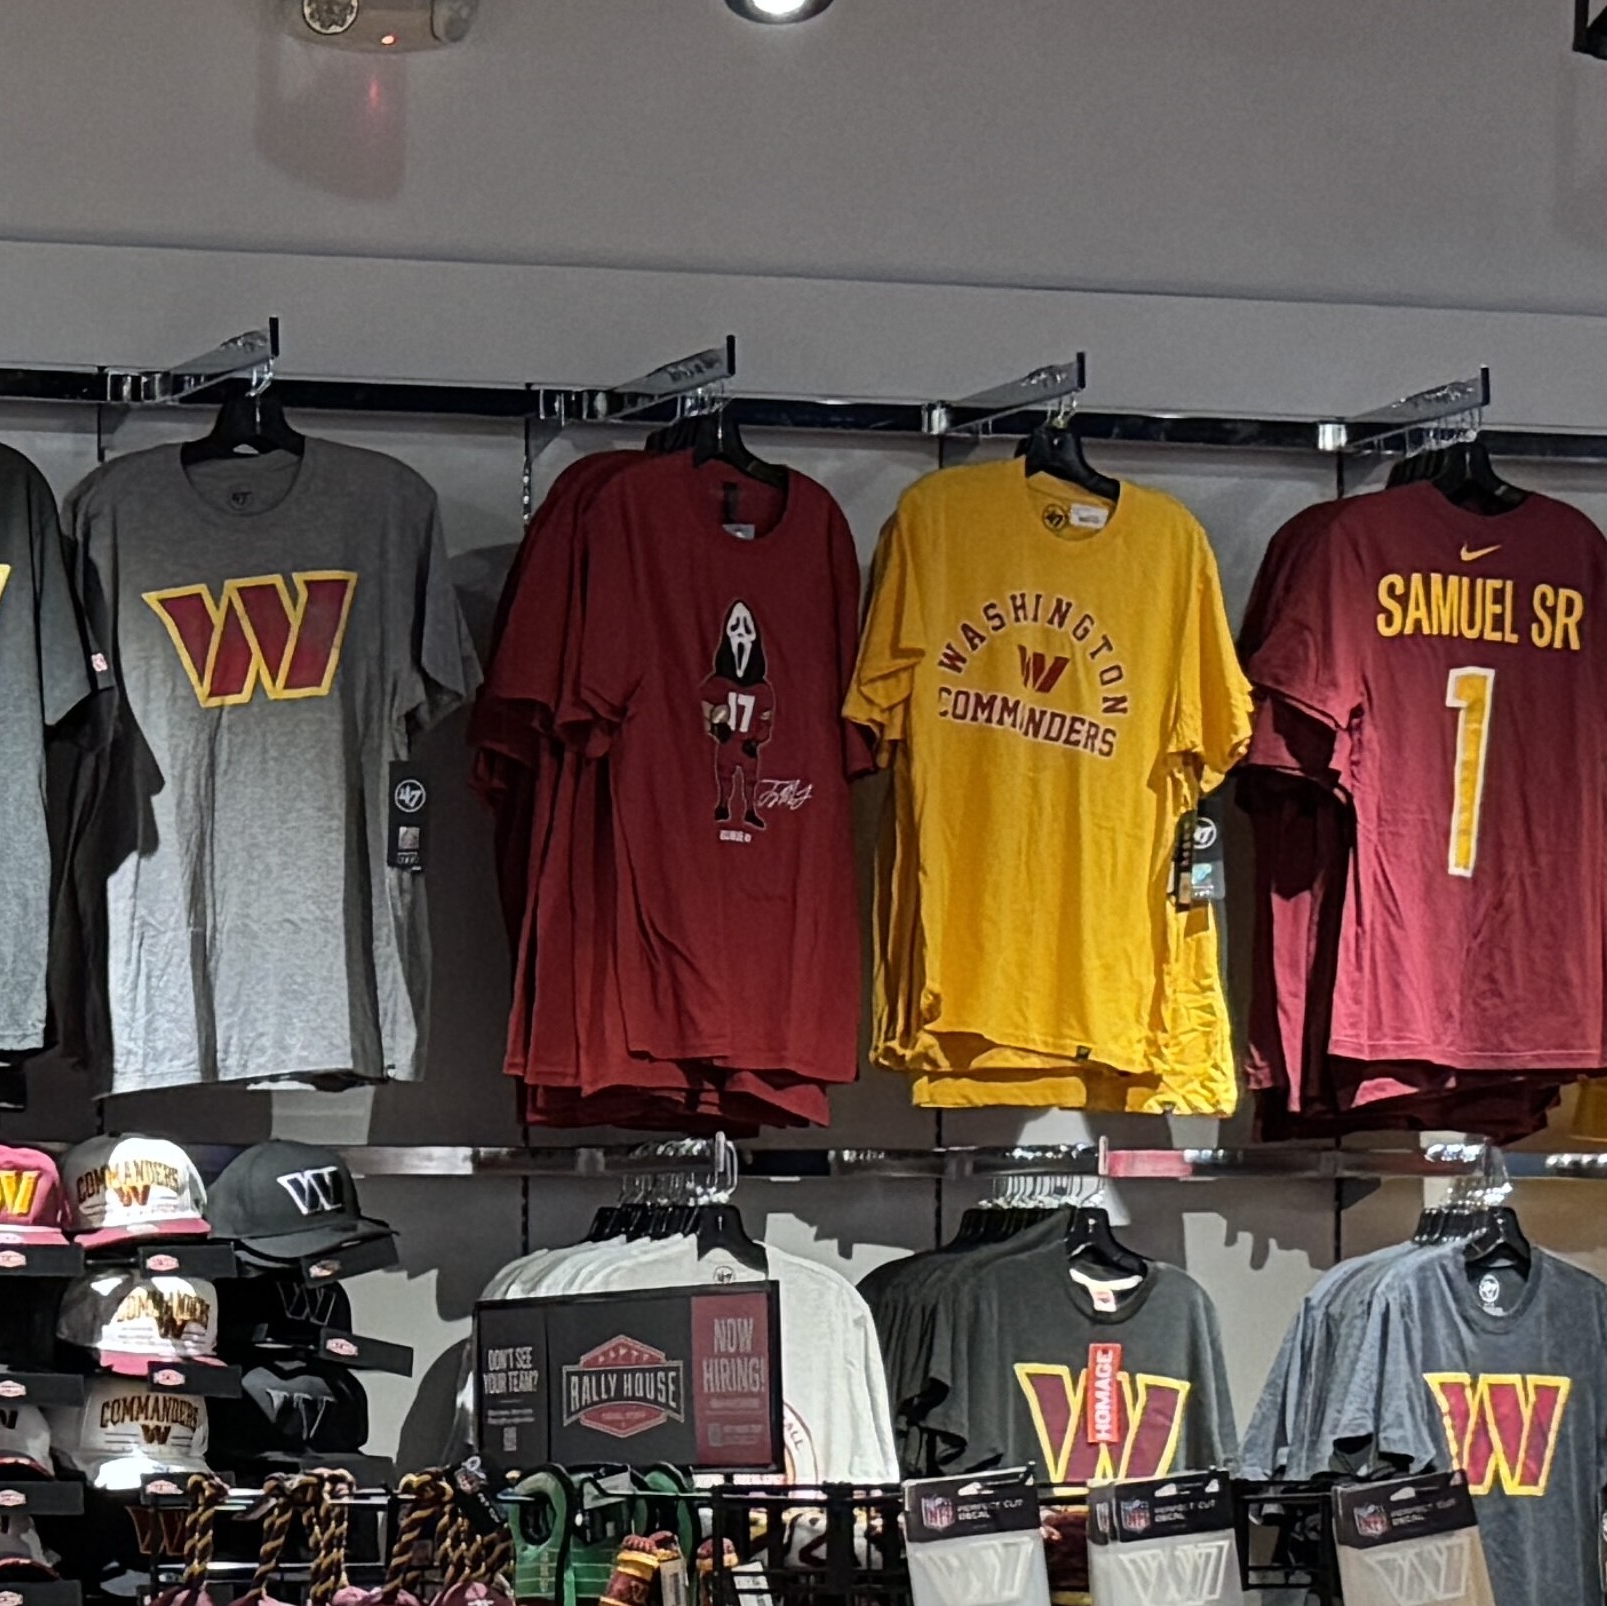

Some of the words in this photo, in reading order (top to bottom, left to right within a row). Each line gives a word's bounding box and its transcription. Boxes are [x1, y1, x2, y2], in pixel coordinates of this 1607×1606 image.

[1377, 573, 1519, 644] SAMUEL
[1532, 584, 1585, 651] SR
[142, 570, 357, 708] W
[938, 593, 1128, 714] WASHINGTON
[727, 692, 755, 733] 17
[939, 686, 1117, 758] COMMNDERS
[1444, 665, 1495, 878] 1
[397, 783, 424, 810] 47
[277, 1166, 344, 1215] W
[714, 1318, 753, 1352] NOW
[488, 1349, 515, 1370] DON'T
[517, 1347, 532, 1369] SEE
[702, 1357, 765, 1392] HIRING!
[484, 1372, 506, 1395] YOUR
[508, 1371, 538, 1392] TEAM?
[571, 1374, 617, 1411] RALLY
[623, 1372, 676, 1408] HOUSE
[1094, 1350, 1113, 1440] HOMAGE
[100, 1395, 198, 1428] COMMANDERS
[1422, 1372, 1572, 1496] W
